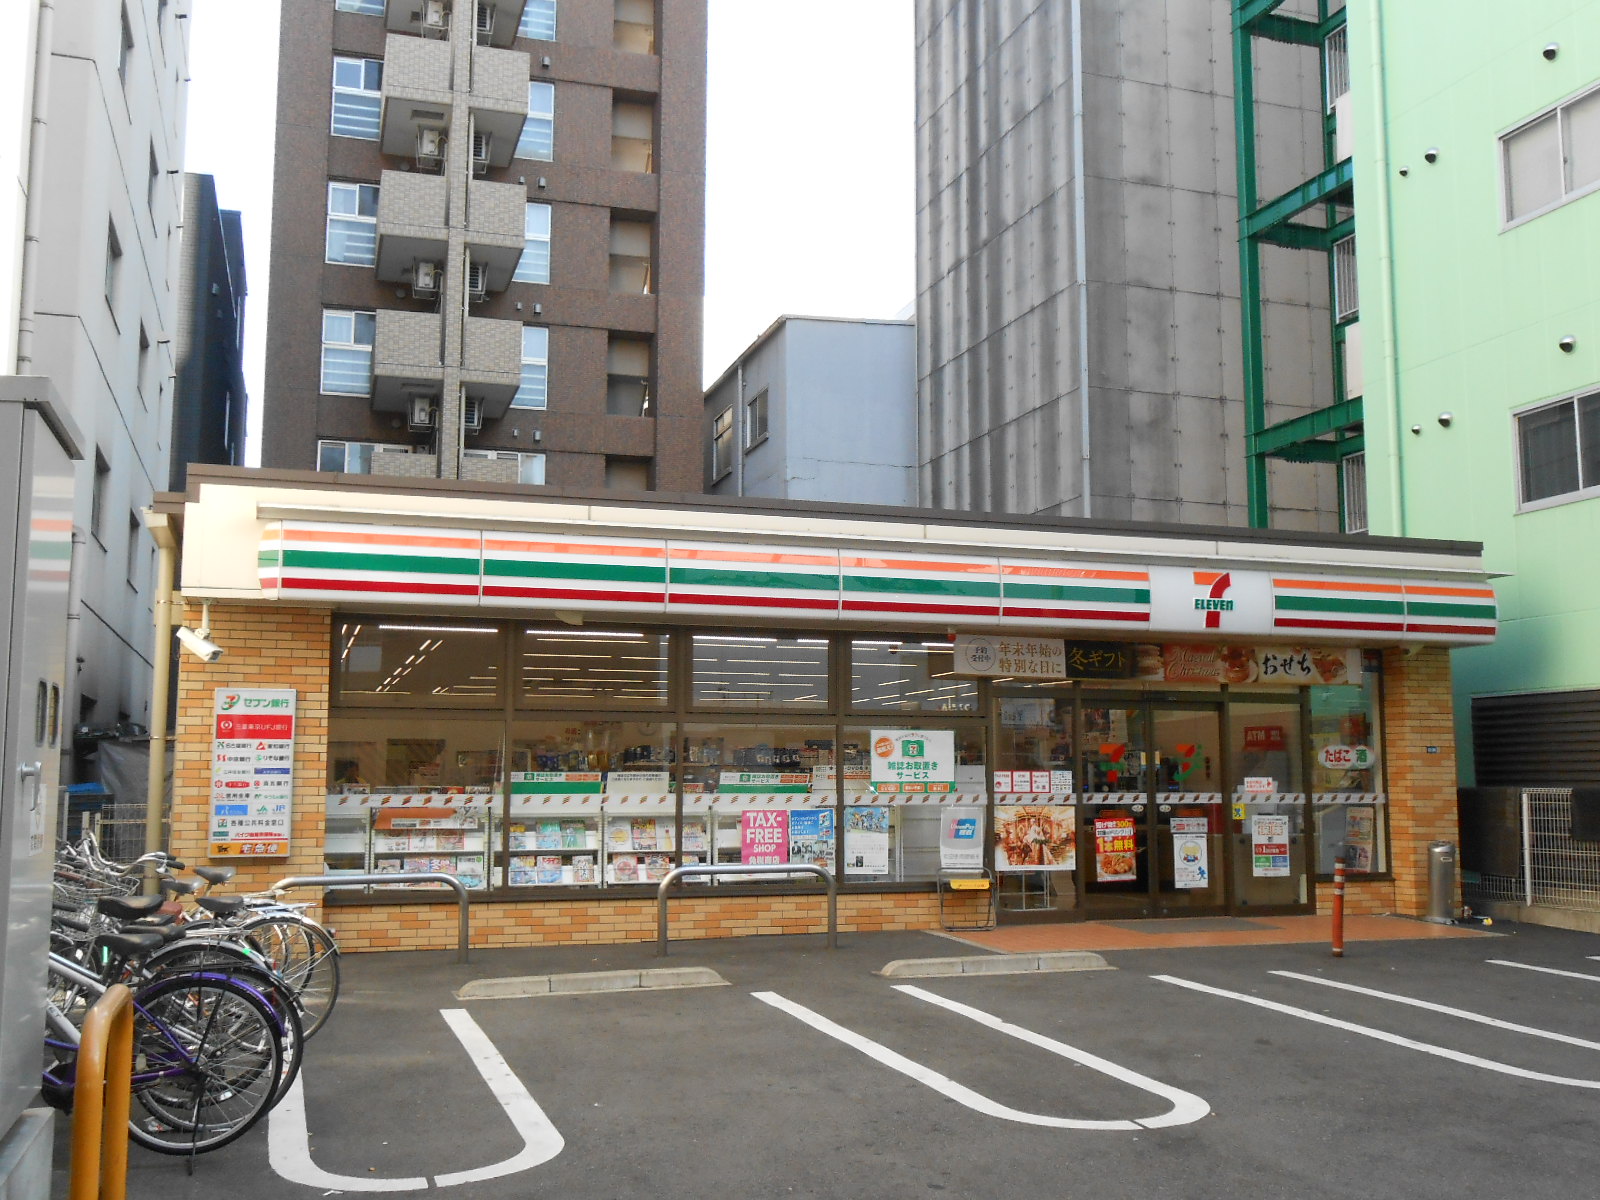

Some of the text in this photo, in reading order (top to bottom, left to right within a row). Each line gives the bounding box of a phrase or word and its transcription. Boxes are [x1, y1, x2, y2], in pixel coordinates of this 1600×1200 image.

[1193, 572, 1231, 628] 7
[999, 641, 1062, 658] 年末年始の
[999, 658, 1062, 674] 特別な日に
[1068, 647, 1127, 671] 冬ギフト
[1262, 652, 1312, 676] おせち
[243, 698, 290, 708] セブン銀行
[1324, 749, 1368, 763] たばこ 酒
[887, 761, 939, 771] 雑誌お取置き
[896, 771, 930, 780] サービス
[746, 812, 782, 828] TAX-
[746, 828, 783, 843] FREE
[240, 843, 279, 854] 宅急便
[753, 844, 777, 853] SHOP
